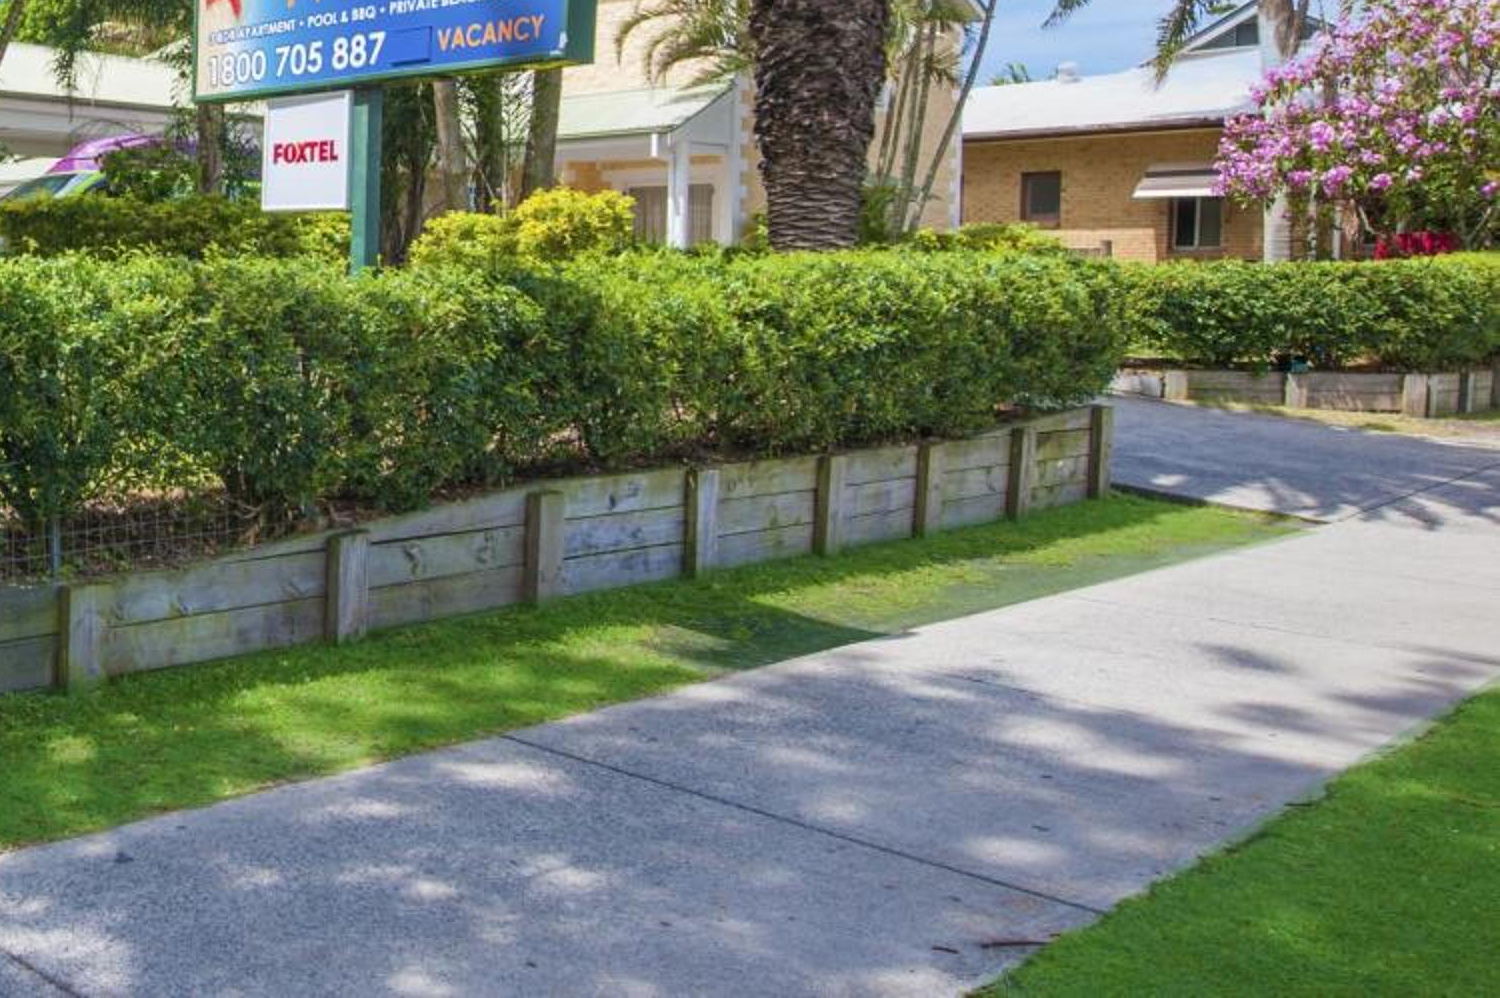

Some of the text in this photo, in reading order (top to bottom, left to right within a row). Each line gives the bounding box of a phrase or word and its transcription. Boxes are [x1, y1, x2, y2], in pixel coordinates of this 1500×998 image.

[307, 13, 337, 28] POOL
[340, 11, 349, 23] &
[352, 5, 376, 20] BBQ
[437, 14, 545, 51] VACANCY
[209, 31, 386, 87] 1800 705 887
[273, 140, 338, 165] FOXTEL
